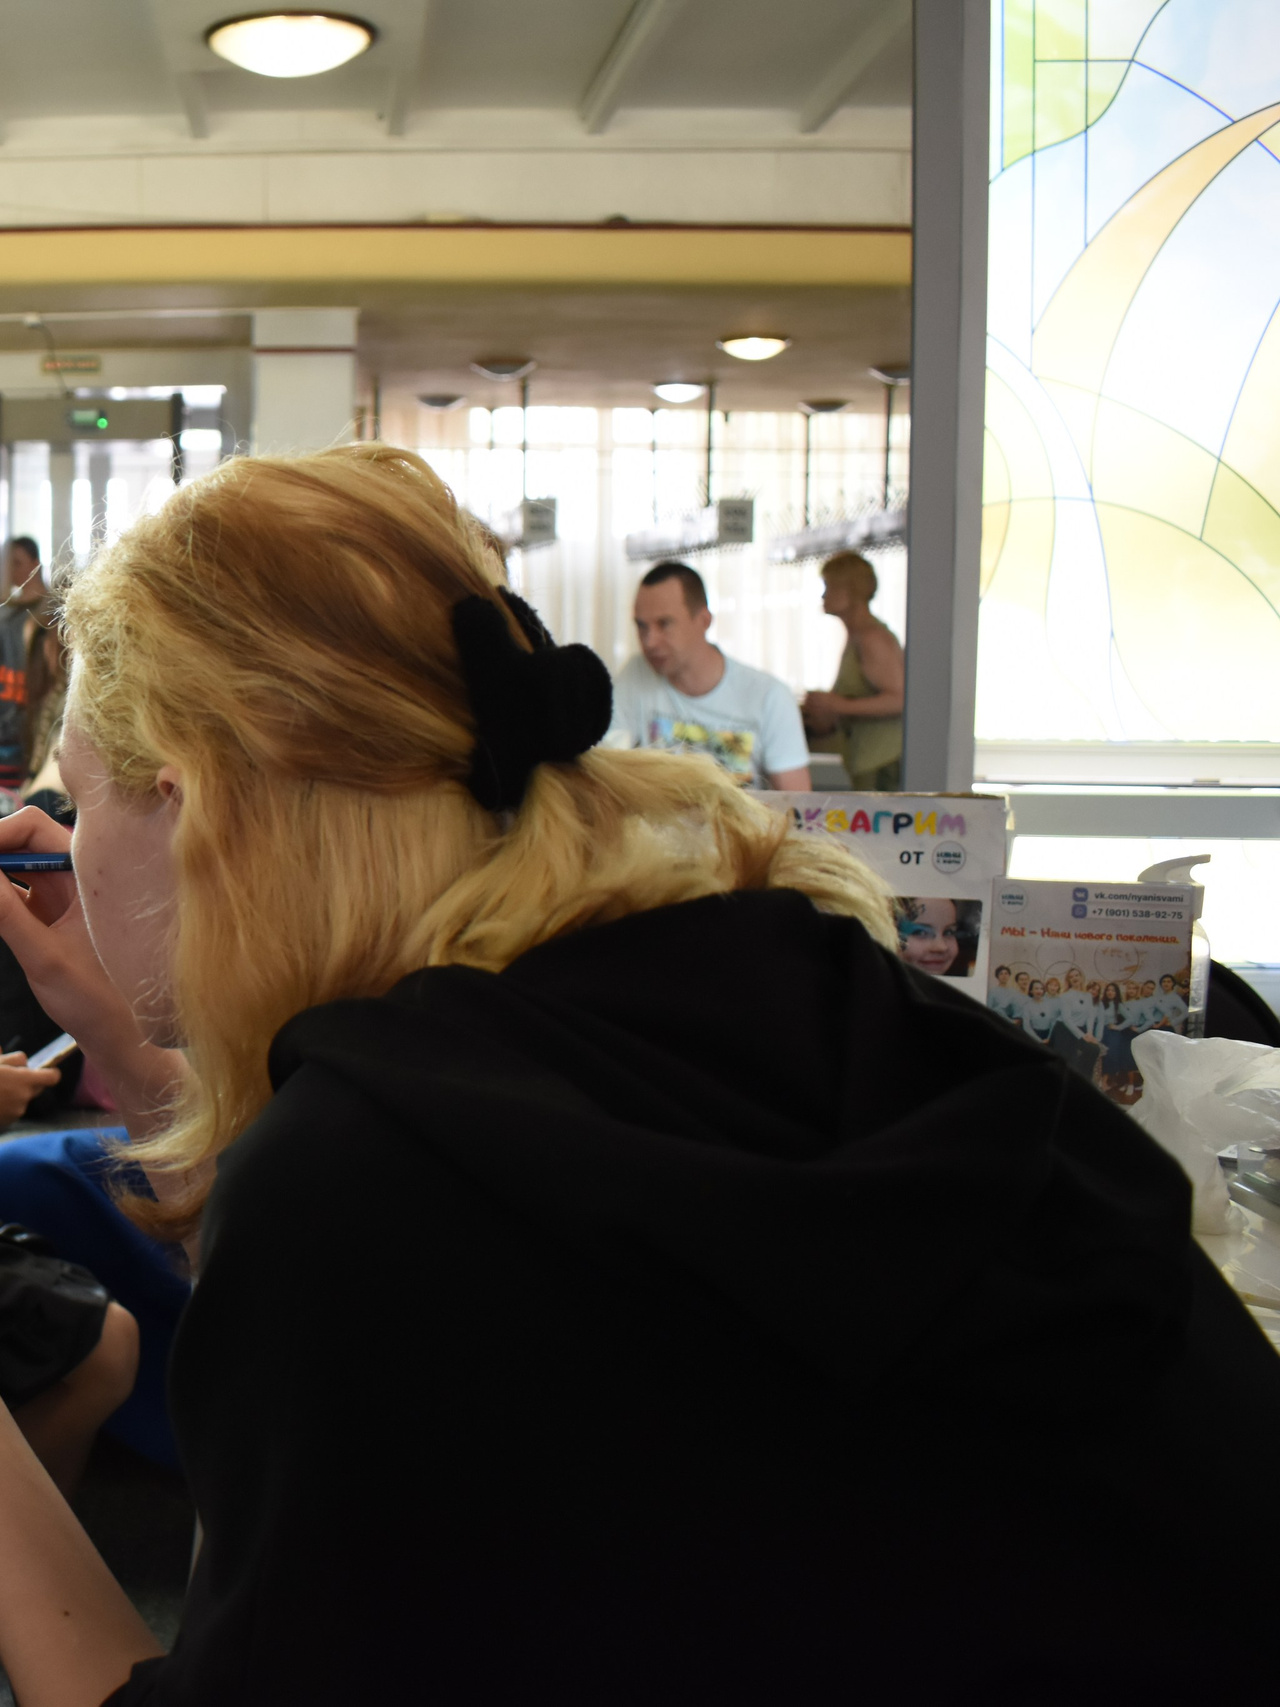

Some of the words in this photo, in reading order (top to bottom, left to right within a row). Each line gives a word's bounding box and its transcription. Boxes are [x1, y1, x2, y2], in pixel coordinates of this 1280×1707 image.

[1094, 892, 1184, 904] vk.com/nyanisvami
[1092, 908, 1103, 916] +7
[1105, 908, 1130, 918] (901)
[1132, 909, 1183, 920] 538-92-75
[1074, 932, 1113, 941] нового
